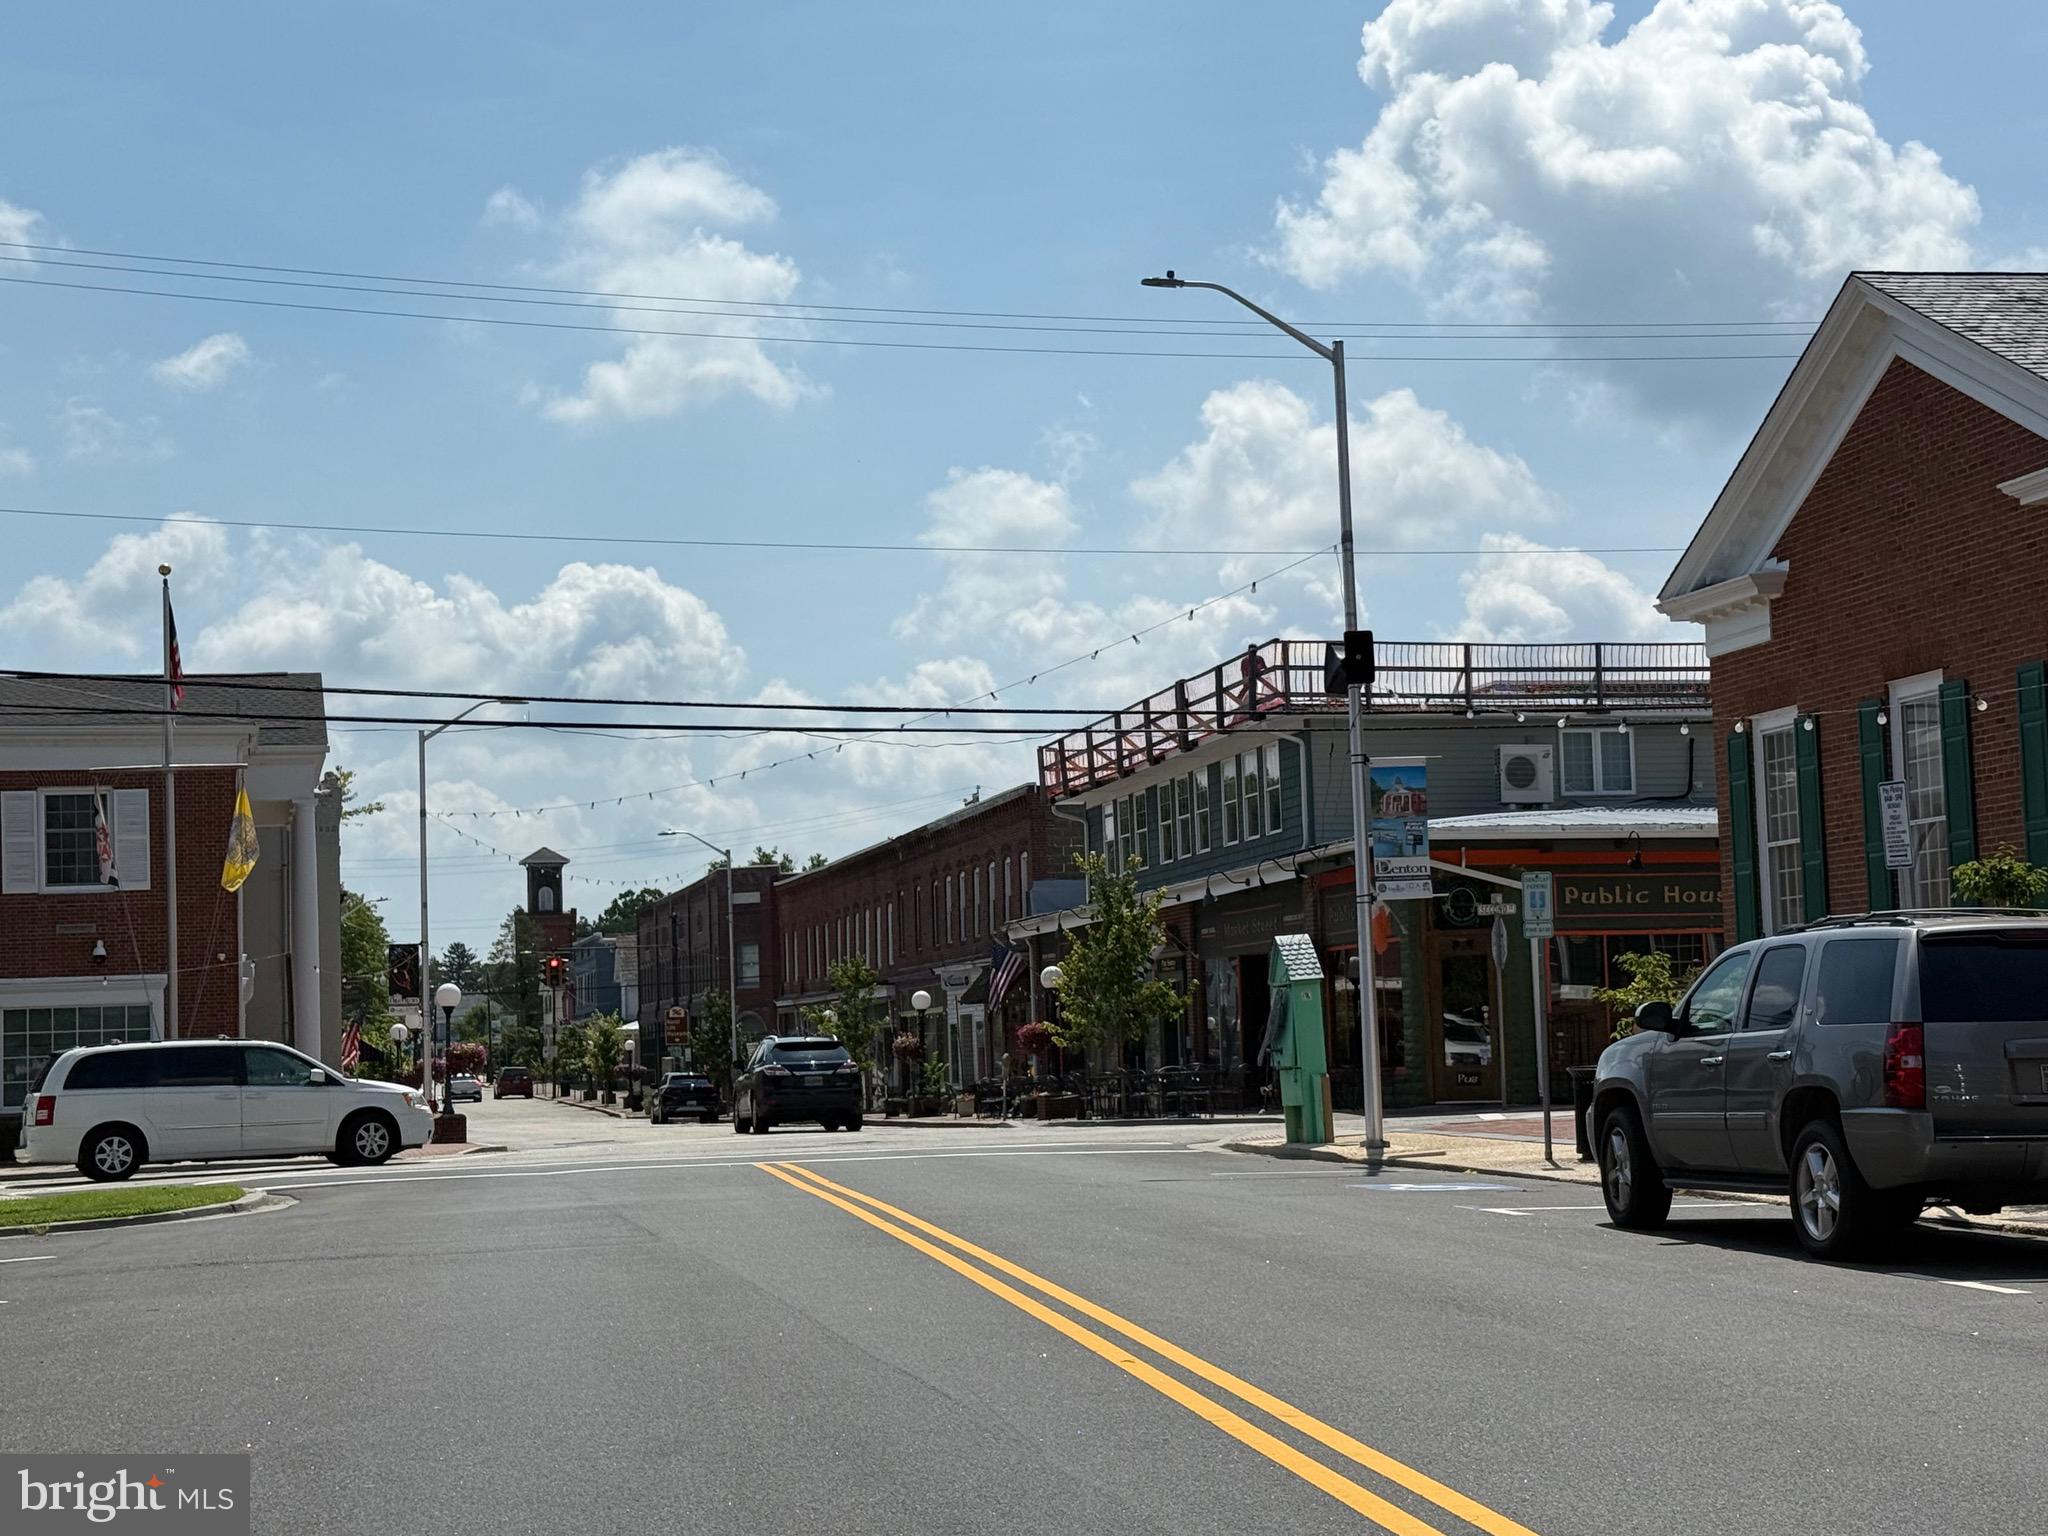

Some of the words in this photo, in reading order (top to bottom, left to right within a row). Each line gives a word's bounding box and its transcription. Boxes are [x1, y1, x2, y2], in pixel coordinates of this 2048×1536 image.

[1376, 860, 1428, 875] Denton
[1564, 884, 1649, 904] Public
[1664, 885, 1723, 904] Hous
[1480, 904, 1508, 914] SECOND
